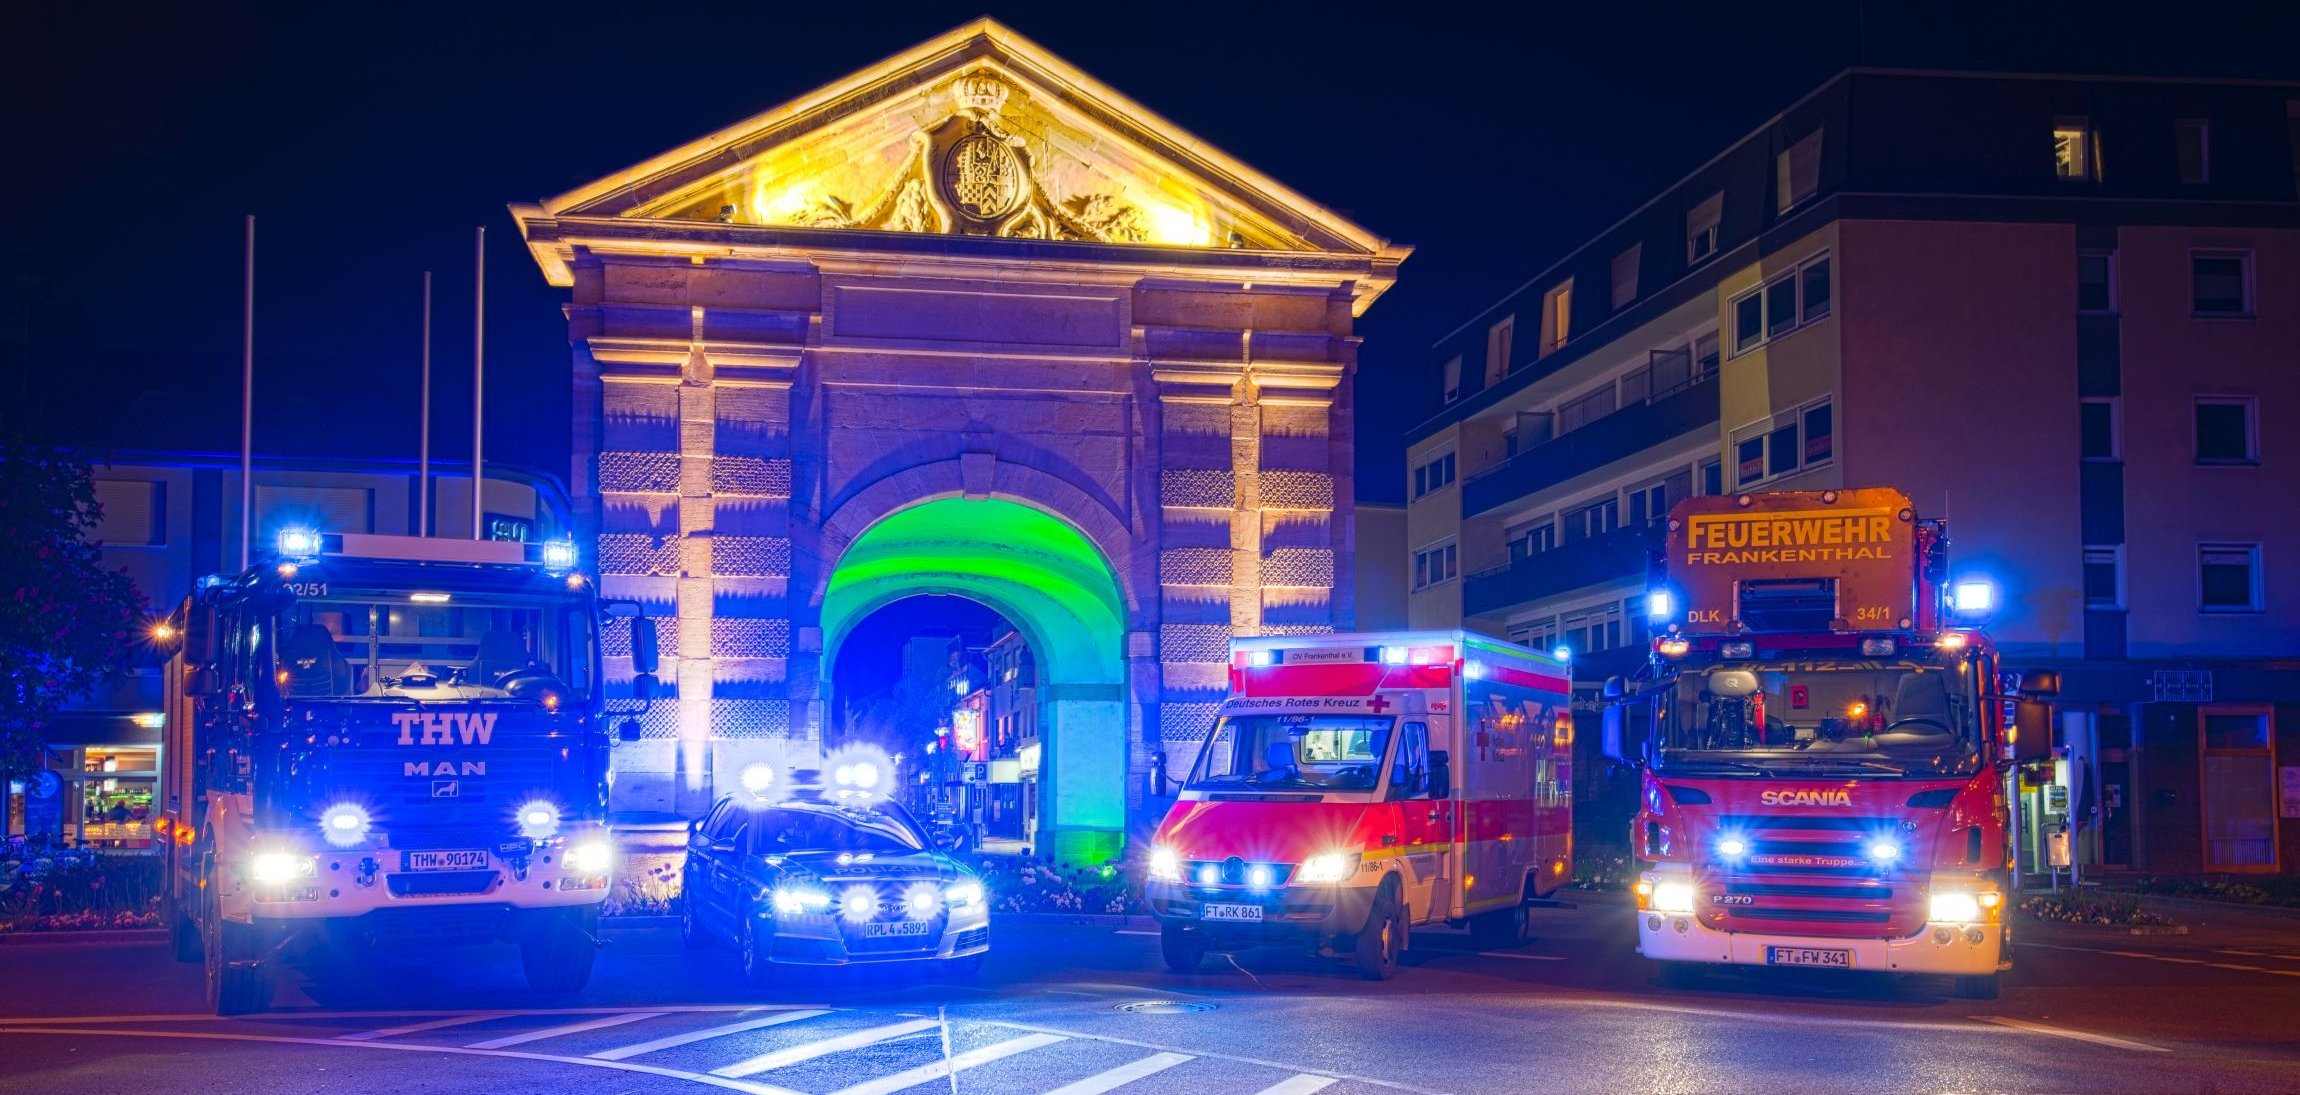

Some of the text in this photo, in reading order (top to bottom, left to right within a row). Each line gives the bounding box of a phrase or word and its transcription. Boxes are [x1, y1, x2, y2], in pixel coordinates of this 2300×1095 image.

[1688, 507, 1892, 549] FEUERWEHR
[1687, 547, 1892, 565] FRANKENTHAL
[1688, 610, 1720, 623] DLK
[1857, 607, 1890, 620] 34/1
[1304, 652, 1340, 660] Frankenthal
[1225, 697, 1360, 709] Deutsches Rotes Kreuz
[391, 713, 498, 745] THW
[404, 761, 486, 776] MAN
[1760, 790, 1852, 806] SCANIA
[412, 852, 484, 867] THW 90174
[1751, 856, 1776, 865] Eine
[1778, 856, 1812, 865] starke
[834, 865, 921, 875] POLIZEI
[1361, 862, 1383, 873] 11/86-1
[1713, 896, 1752, 904] P 270
[1206, 906, 1261, 918] FT RK 861
[866, 921, 928, 937] RPL 4 5891
[1776, 950, 1848, 965] FT FW 341
